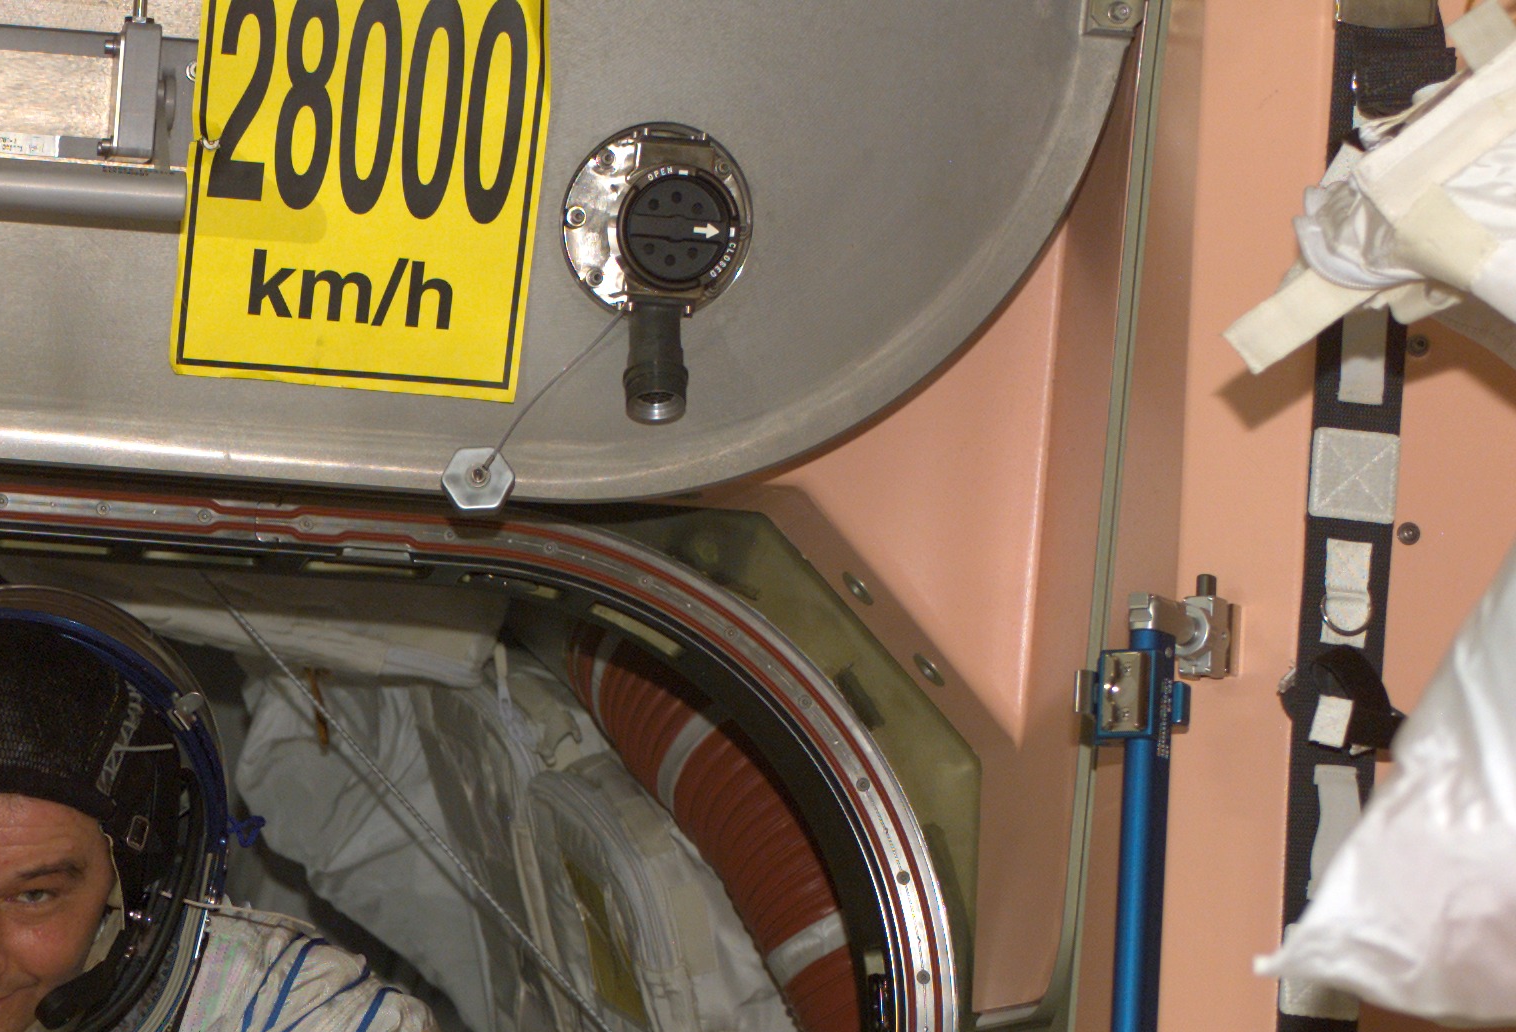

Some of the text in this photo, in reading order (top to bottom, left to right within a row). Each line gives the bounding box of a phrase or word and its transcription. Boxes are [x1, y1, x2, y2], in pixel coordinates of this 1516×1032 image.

[207, 0, 528, 225] 28000
[647, 166, 673, 181] OPEN
[248, 248, 454, 330] km/h
[709, 242, 737, 278] CLOSED
